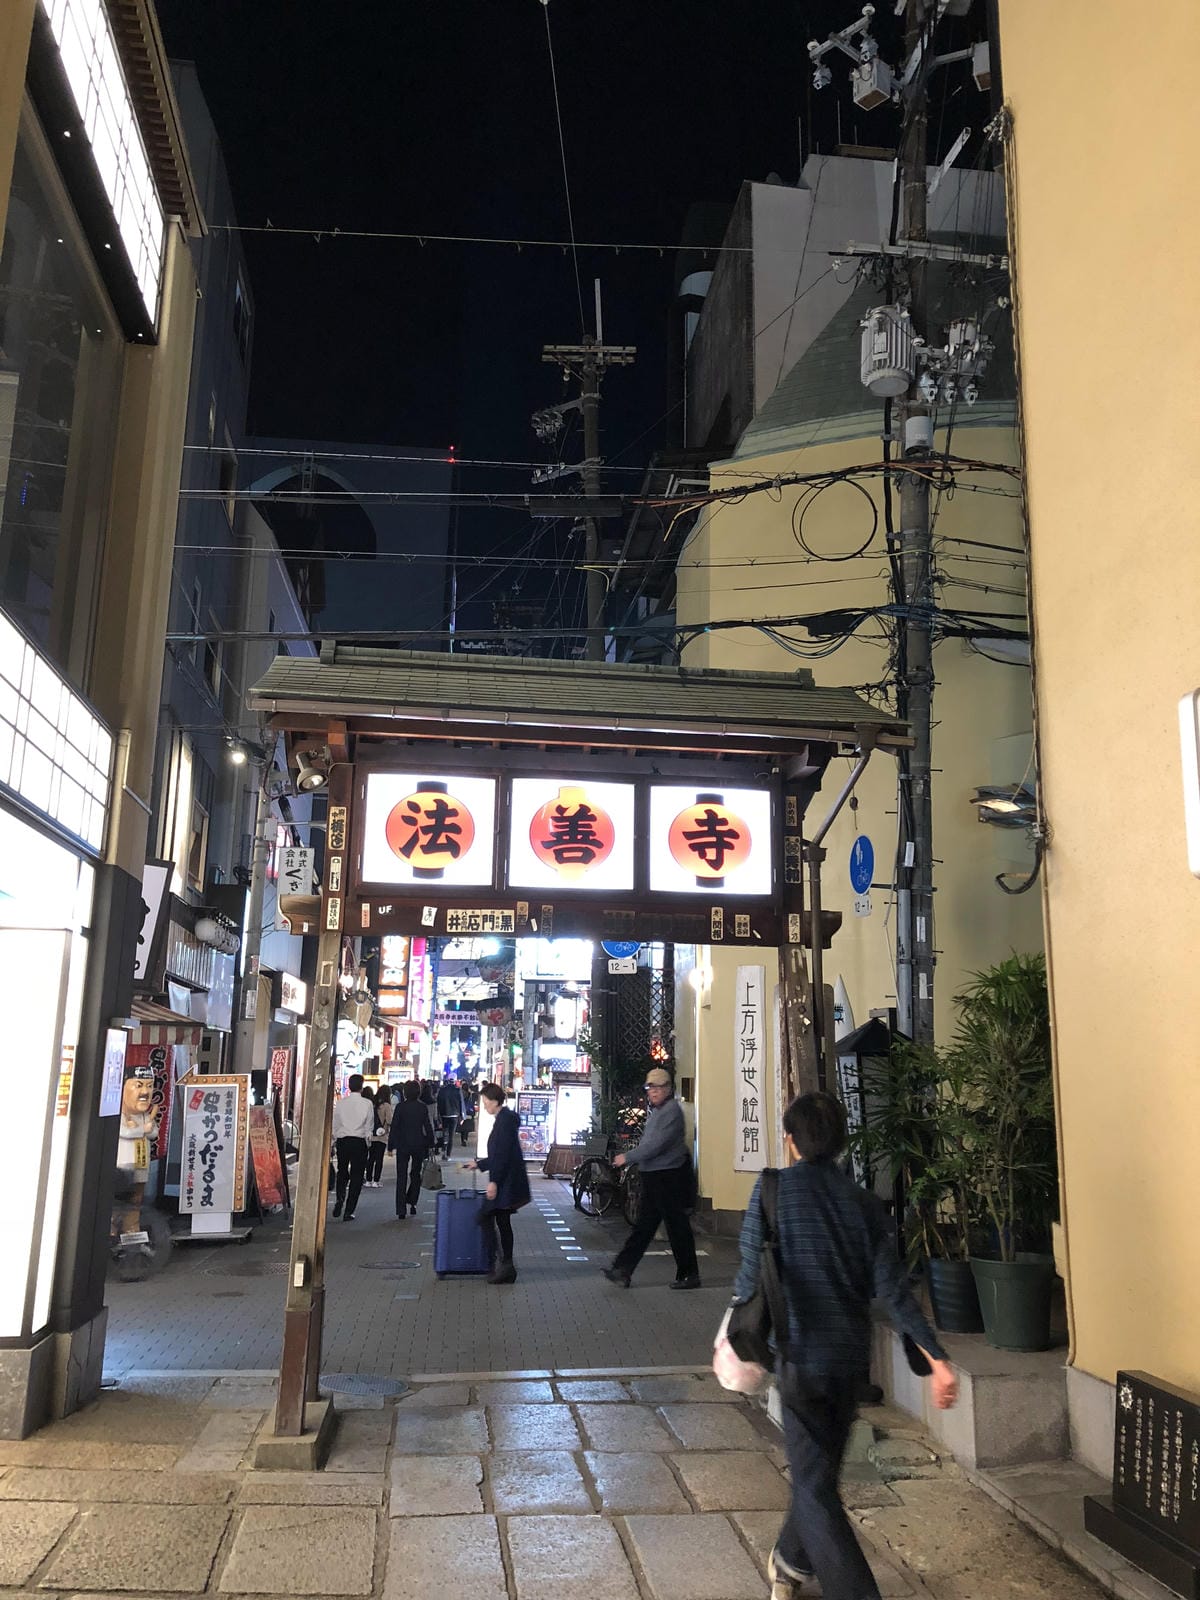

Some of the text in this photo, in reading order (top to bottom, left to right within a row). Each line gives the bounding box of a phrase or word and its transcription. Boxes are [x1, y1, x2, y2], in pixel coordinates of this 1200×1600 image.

[399, 799, 740, 871] 法善寺
[273, 1051, 286, 1087] 松竹芸
[741, 982, 759, 1153] 上方浮世絵館
[199, 1091, 224, 1207] 串かつだるま
